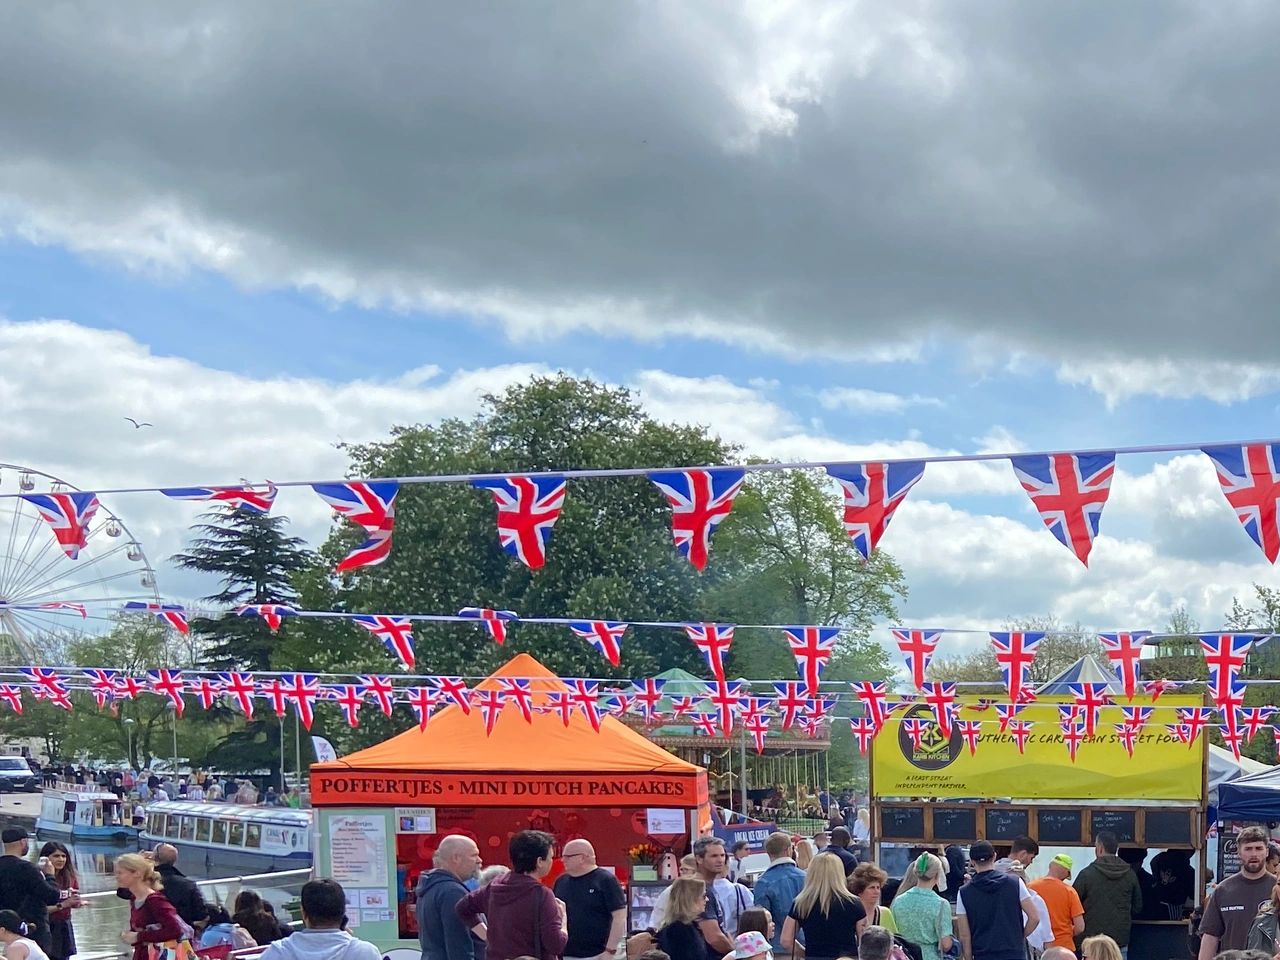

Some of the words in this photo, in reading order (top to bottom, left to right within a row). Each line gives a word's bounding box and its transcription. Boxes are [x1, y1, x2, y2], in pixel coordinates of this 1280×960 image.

[320, 778, 443, 798] POFFERTJES
[459, 780, 508, 796] MINI
[512, 781, 582, 796] DUTCH
[588, 780, 684, 796] PANCAKES
